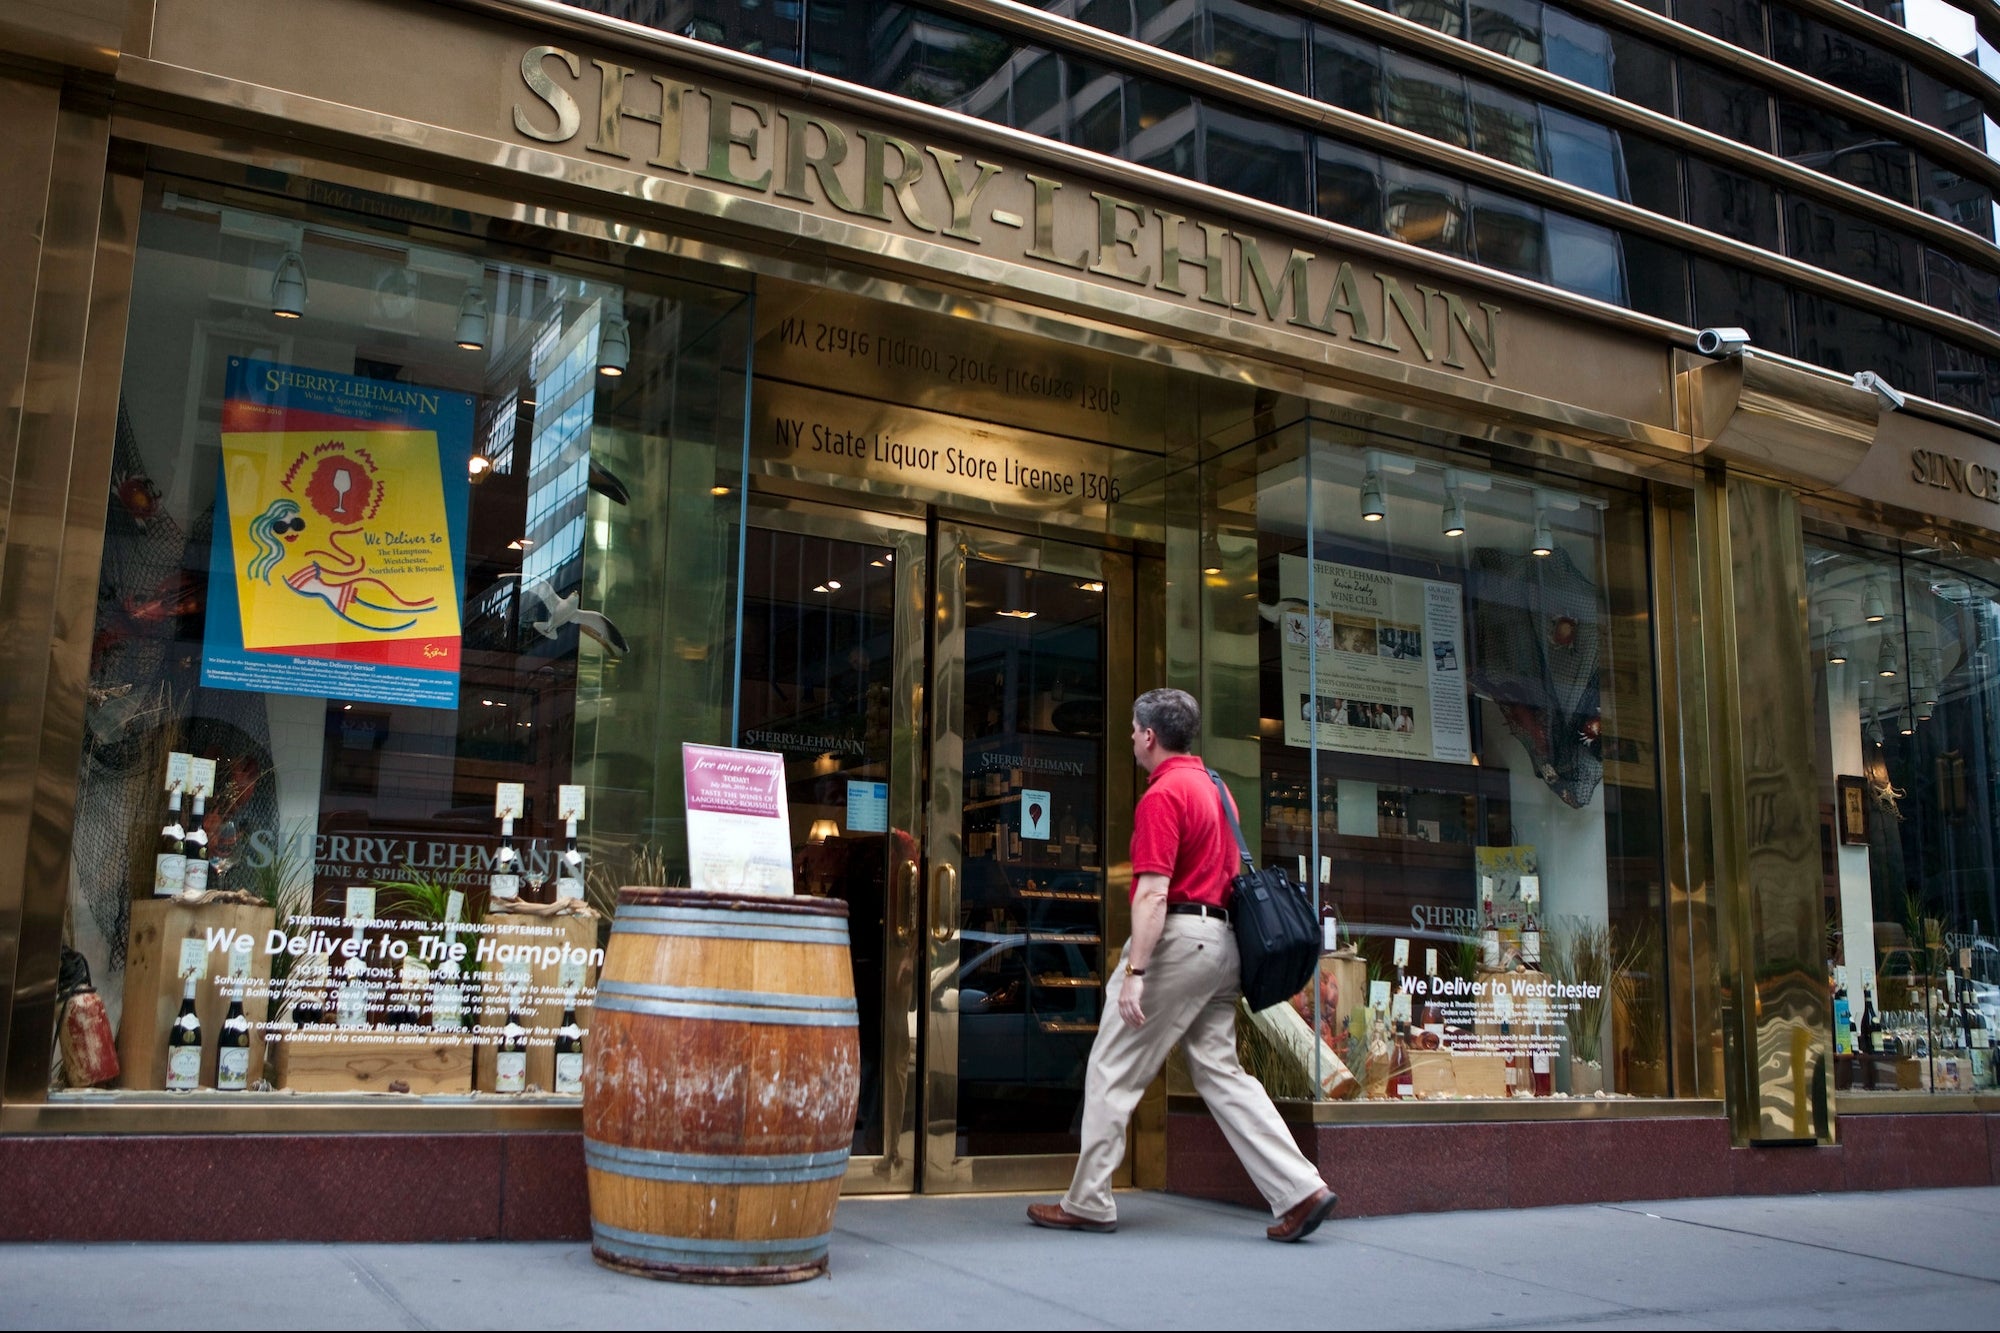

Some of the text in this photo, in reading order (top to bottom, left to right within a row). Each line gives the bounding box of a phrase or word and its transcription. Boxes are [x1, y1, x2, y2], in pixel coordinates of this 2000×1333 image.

[513, 45, 1501, 379] SHERRY-LEHMANN
[265, 369, 440, 415] SHERRY-LEHMANN
[776, 417, 1120, 504] NY State Liquor Store License 1306
[1912, 448, 2000, 504] SINCE
[364, 531, 442, 546] We Deliver to
[377, 548, 432, 556] The Hamptons,
[1330, 590, 1378, 606] WINE CLUB
[745, 730, 866, 755] SHERRY-LEHMANN
[690, 756, 780, 782] free wine tasting
[981, 752, 1084, 776] SHERRY-LEHMANN
[722, 774, 750, 785] TODAY!
[700, 788, 722, 798] TASTE
[724, 790, 737, 799] THE
[739, 792, 762, 802] WINES
[249, 828, 589, 887] SHERRY-LEHMANN
[312, 862, 527, 888] WINE & SPIRITS MERCHANTS
[288, 915, 566, 936] STARTING SATURDAY, APRIL 24 THROUGH SEPTEMBER 11
[206, 926, 255, 953] We
[264, 929, 374, 959] Deliver
[380, 934, 409, 959] to
[418, 935, 468, 962] The
[312, 966, 332, 977] THE
[334, 966, 397, 979] HAMPTONS,
[399, 968, 461, 980] NORTHFORK
[463, 970, 471, 981] &
[473, 971, 493, 981] FIRE
[220, 986, 244, 997] from
[246, 988, 281, 1000] Baiting
[282, 989, 317, 999] Hollow
[318, 990, 328, 999] to
[330, 990, 360, 999] Orient
[362, 991, 386, 1000] Point
[390, 992, 410, 1001] and
[412, 992, 421, 1001] to
[528, 996, 533, 1004] 3
[269, 978, 286, 986] our
[288, 978, 324, 989] special
[326, 978, 347, 988] Blue
[349, 980, 384, 990] Ribbon
[422, 981, 458, 992] delivers
[459, 982, 481, 992] from
[482, 984, 500, 994] Bay
[530, 985, 539, 994] to
[1400, 976, 1602, 998] We Deliver to Westchester
[288, 1002, 299, 1010] or
[300, 1002, 322, 1010] over
[386, 1004, 406, 1012] can
[408, 1002, 420, 1012] be
[460, 1006, 471, 1014] up
[473, 1005, 483, 1014] to
[256, 1020, 298, 1032] ordering
[302, 1020, 337, 1032] please
[338, 1022, 375, 1033] specify
[376, 1022, 397, 1032] Blue
[398, 1023, 432, 1033] Ribbon
[472, 1024, 504, 1034] Orders
[534, 1026, 550, 1035] the
[284, 1032, 331, 1042] delivered
[334, 1034, 350, 1042] via
[351, 1034, 395, 1044] common
[396, 1034, 428, 1043] carrier
[430, 1034, 463, 1046] usually
[464, 1035, 491, 1044] within
[492, 1036, 504, 1045] 24
[506, 1036, 514, 1044] to
[516, 1036, 528, 1046] 48
